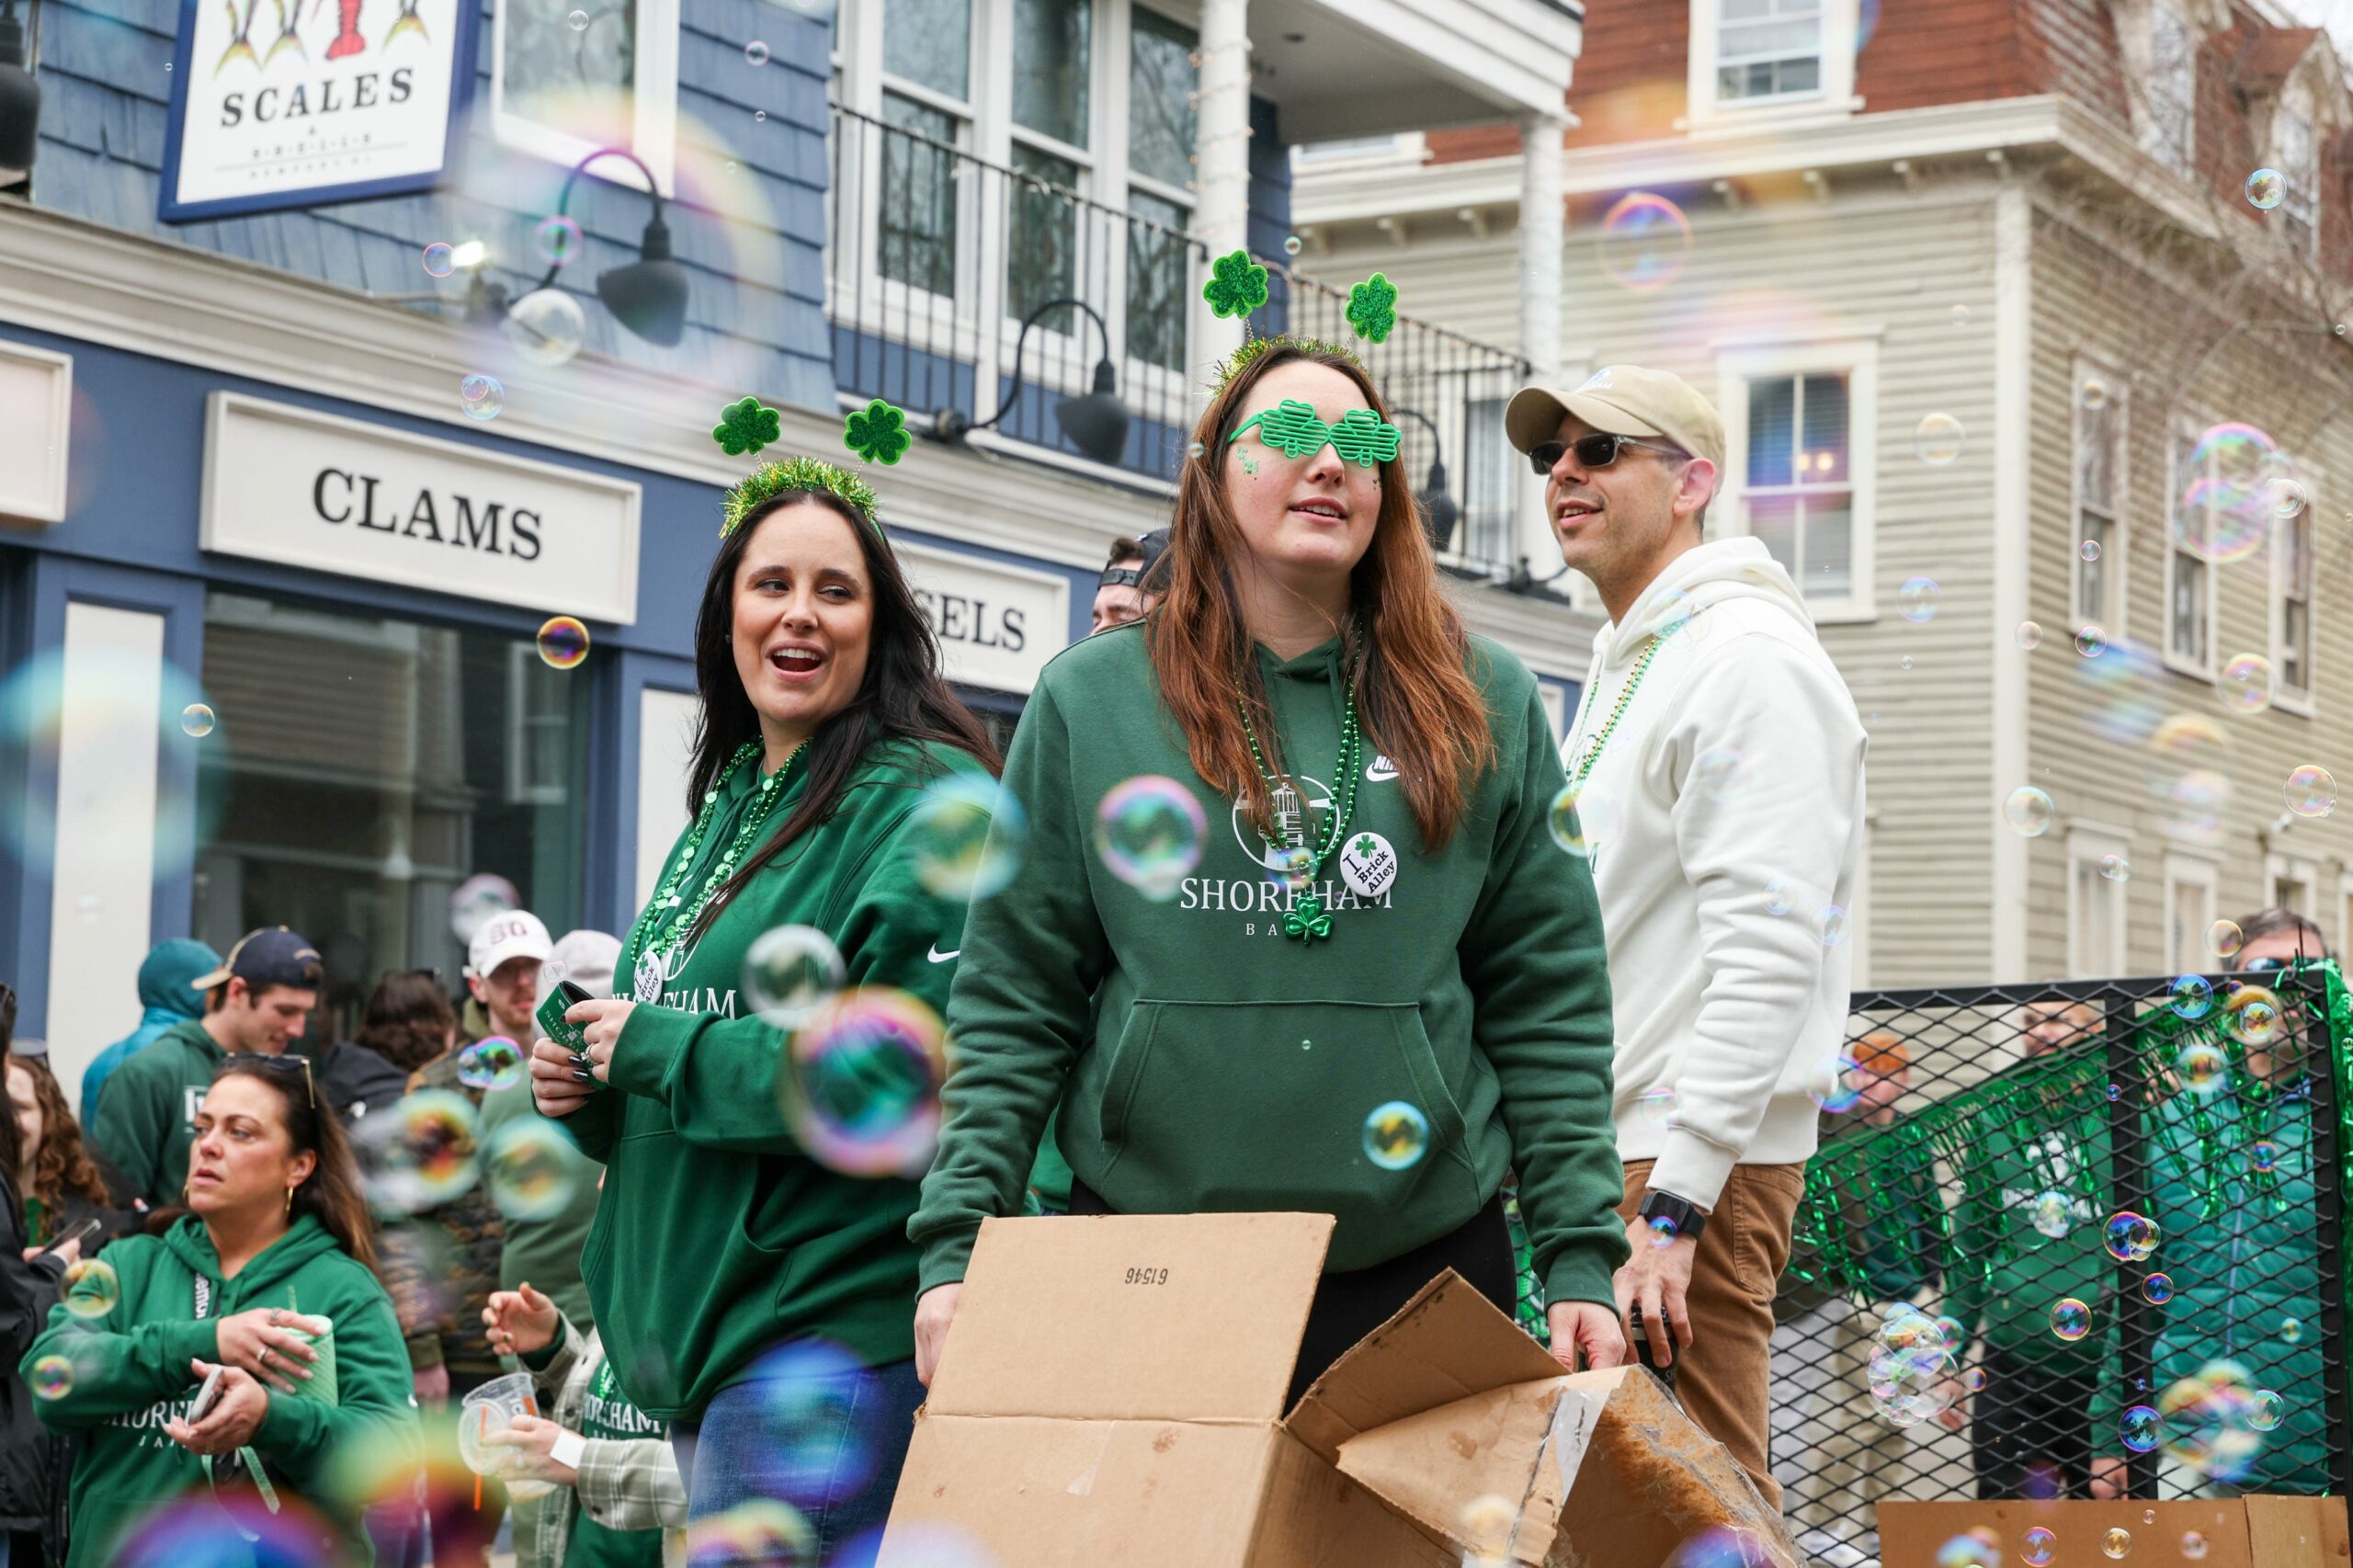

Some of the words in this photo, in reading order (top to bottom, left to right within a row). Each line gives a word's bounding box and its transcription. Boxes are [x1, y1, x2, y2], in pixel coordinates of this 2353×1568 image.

[222, 68, 413, 127] SCALES
[313, 468, 540, 561] CLAMS
[911, 587, 1026, 653] SELS
[1342, 853, 1362, 875] I
[1357, 850, 1389, 884] Brick
[1368, 861, 1395, 894] Alley
[1125, 1267, 1168, 1285] 61546
